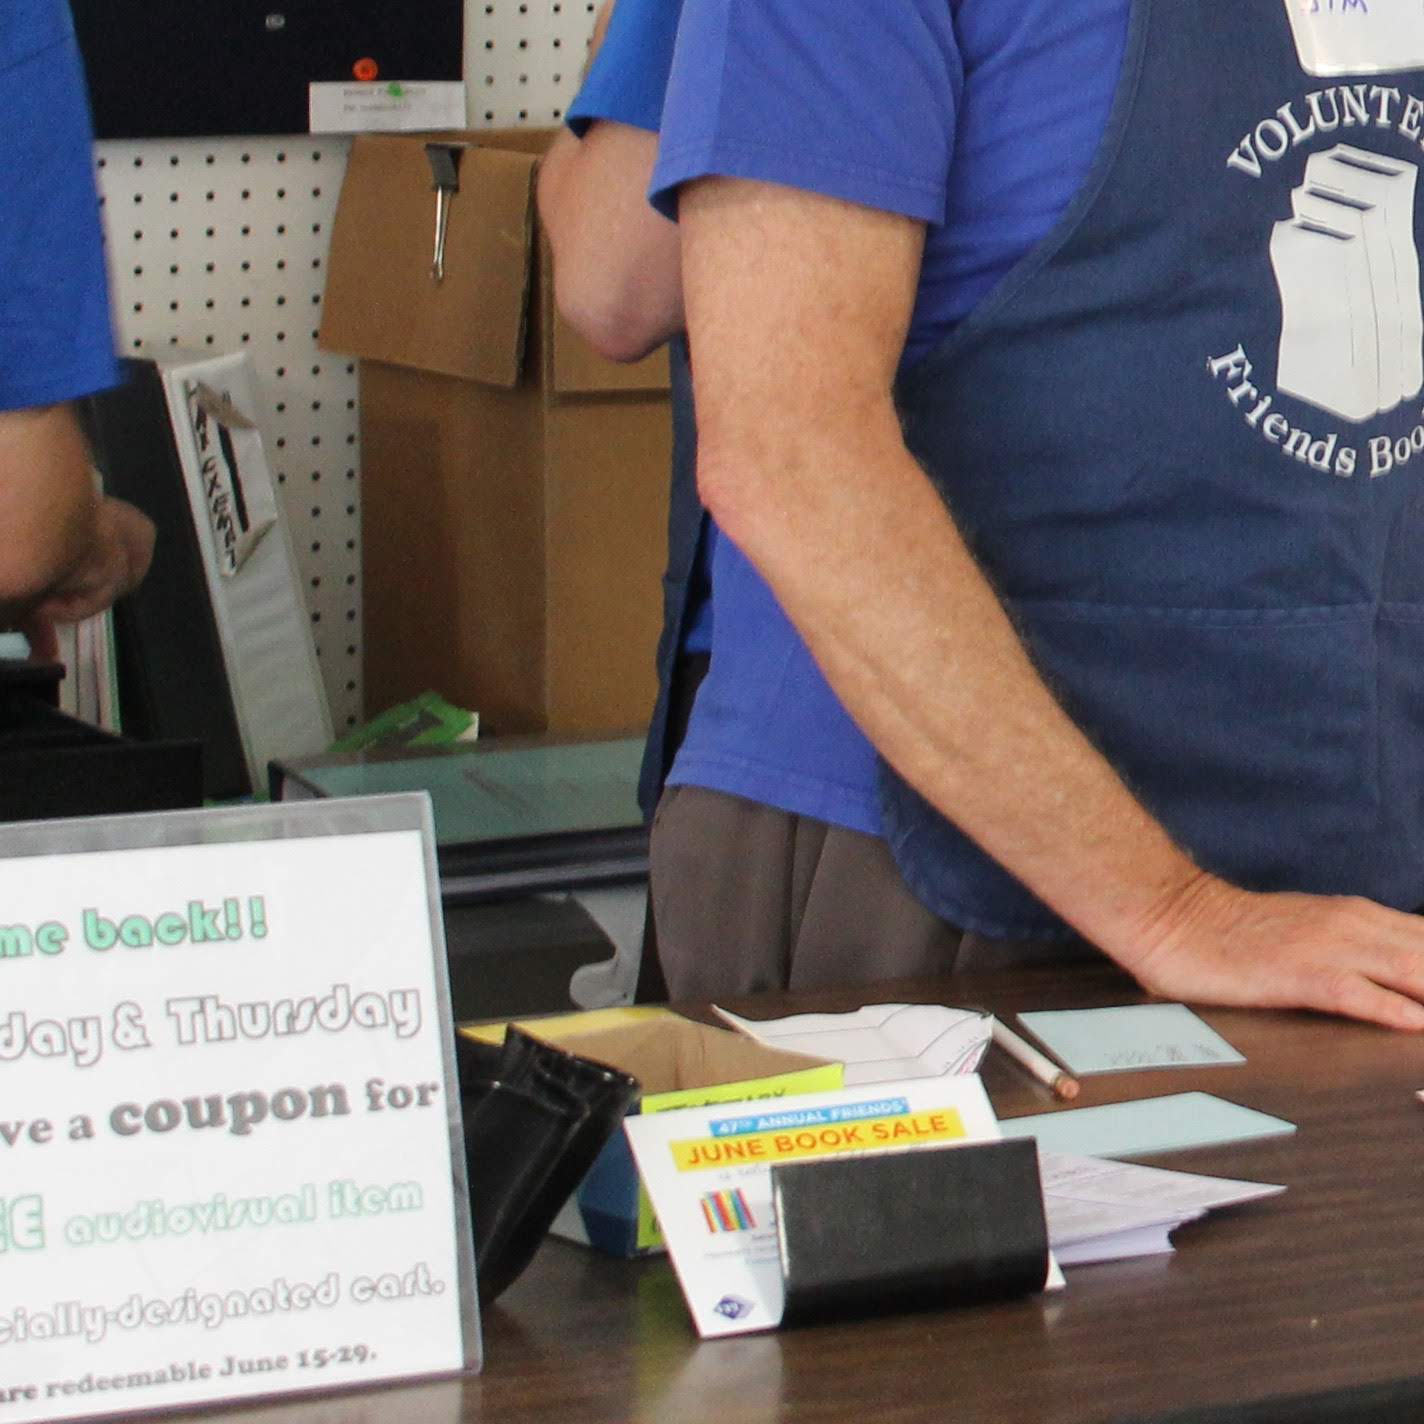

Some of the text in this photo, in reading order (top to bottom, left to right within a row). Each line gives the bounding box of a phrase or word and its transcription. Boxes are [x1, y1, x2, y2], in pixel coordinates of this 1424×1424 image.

[1207, 343, 1358, 478] Friends
[82, 894, 269, 951] back!!
[112, 1002, 152, 1050] &
[167, 984, 422, 1045] Thursday
[68, 1112, 95, 1141] a
[110, 1080, 351, 1138] coupon
[365, 1078, 440, 1114] for
[757, 1110, 828, 1132] ANNUAL
[688, 1114, 949, 1166] JUNE BOOK SALE
[65, 1177, 424, 1247] audiovisual item
[350, 1262, 446, 1303] cart.
[46, 1360, 212, 1400] redeemable
[220, 1351, 289, 1380] June
[297, 1342, 378, 1369] 15-29.
